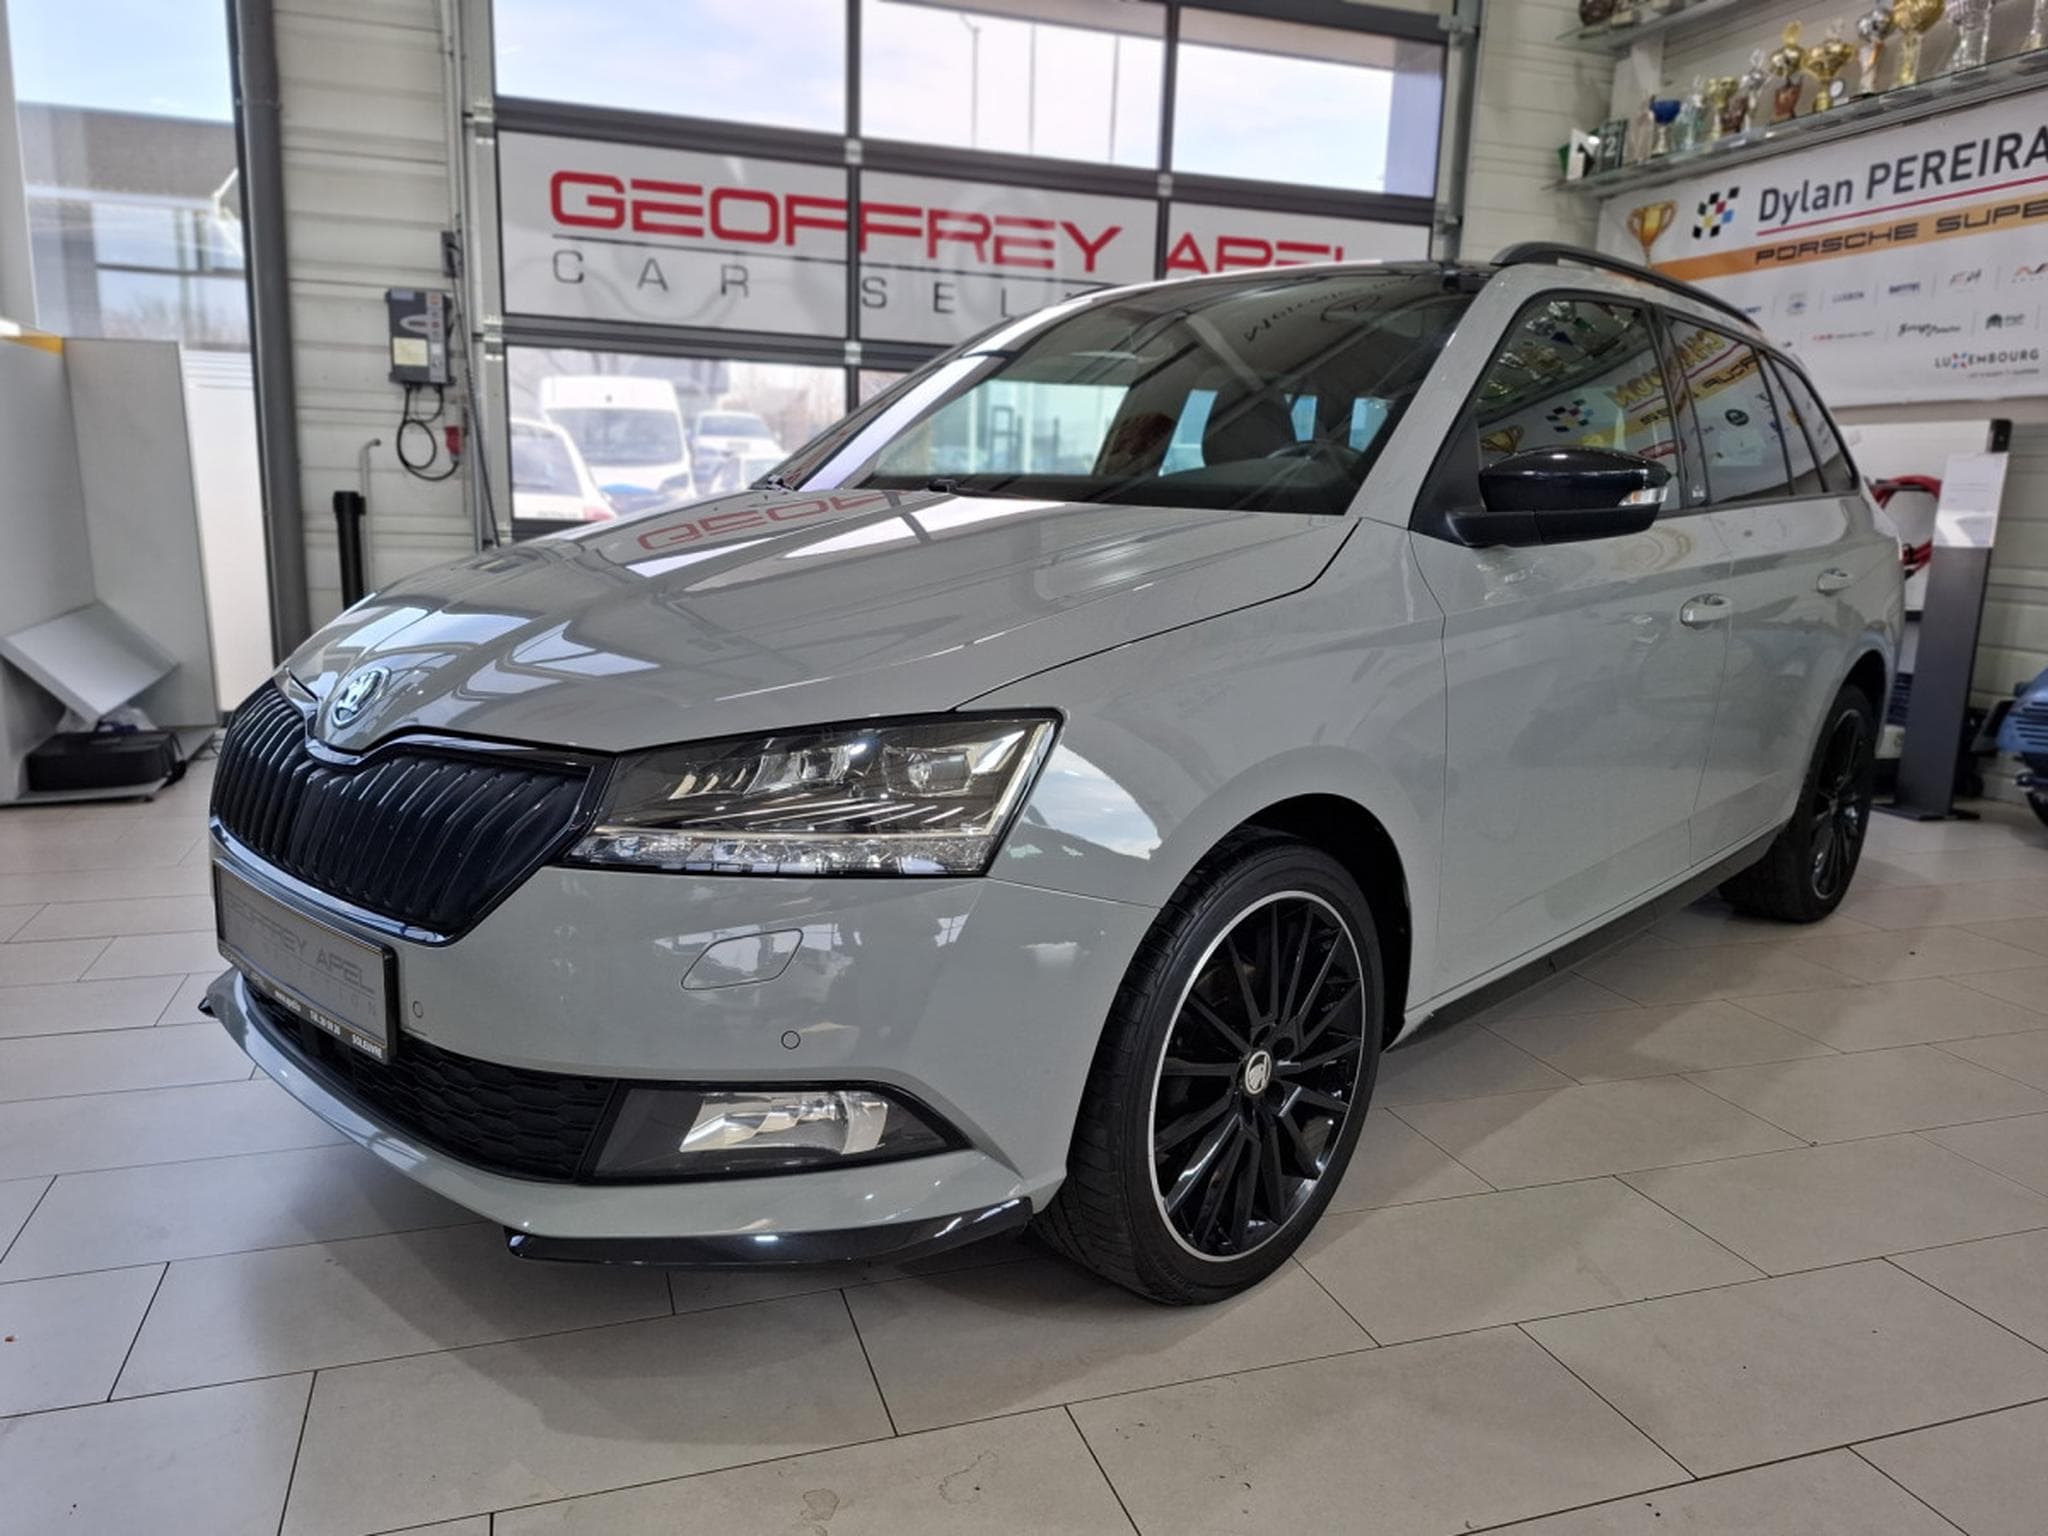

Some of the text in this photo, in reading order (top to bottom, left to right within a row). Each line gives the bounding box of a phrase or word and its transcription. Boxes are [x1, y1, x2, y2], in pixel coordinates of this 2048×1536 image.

[1759, 125, 2048, 226] Dylan PEREIRA
[550, 170, 1122, 273] GEOFFREY
[1755, 222, 1919, 265] PORSCHE
[552, 249, 1074, 323] CAR SEL
[1935, 349, 2040, 369] LUXEMBOURG
